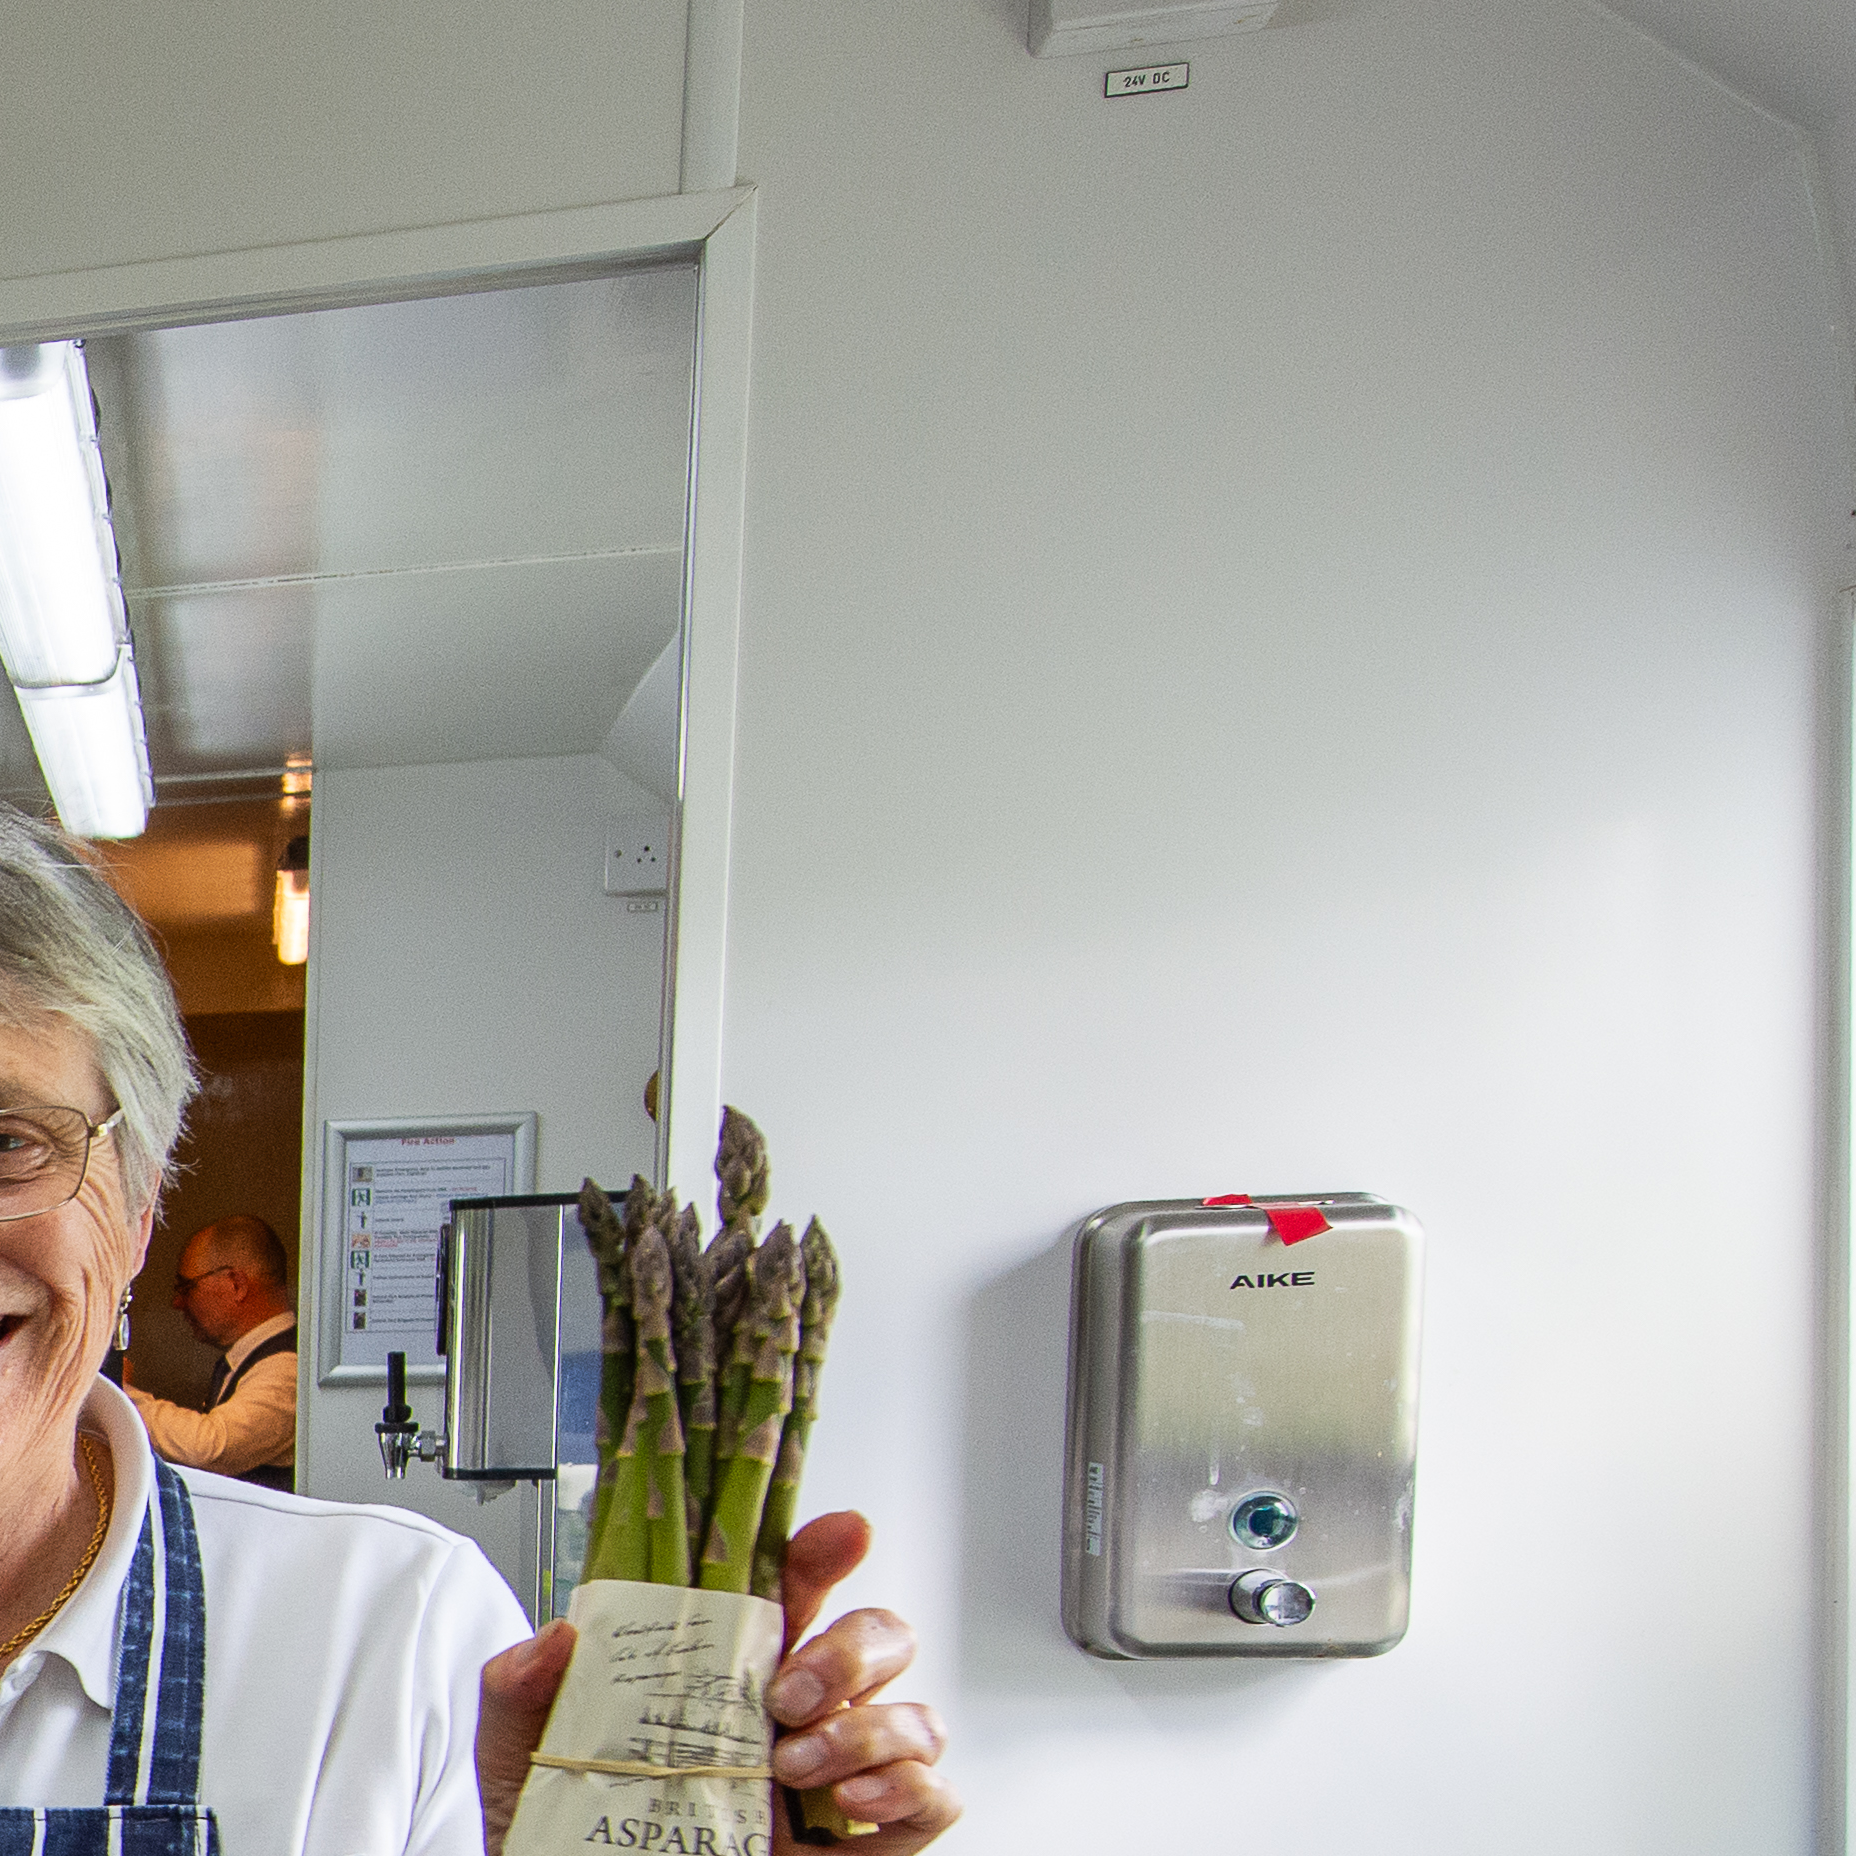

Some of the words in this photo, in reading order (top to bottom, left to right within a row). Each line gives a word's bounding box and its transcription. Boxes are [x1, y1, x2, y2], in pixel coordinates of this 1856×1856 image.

[1123, 74, 1146, 88] 24V
[1152, 71, 1171, 84] DC
[1230, 1271, 1316, 1290] AIKE
